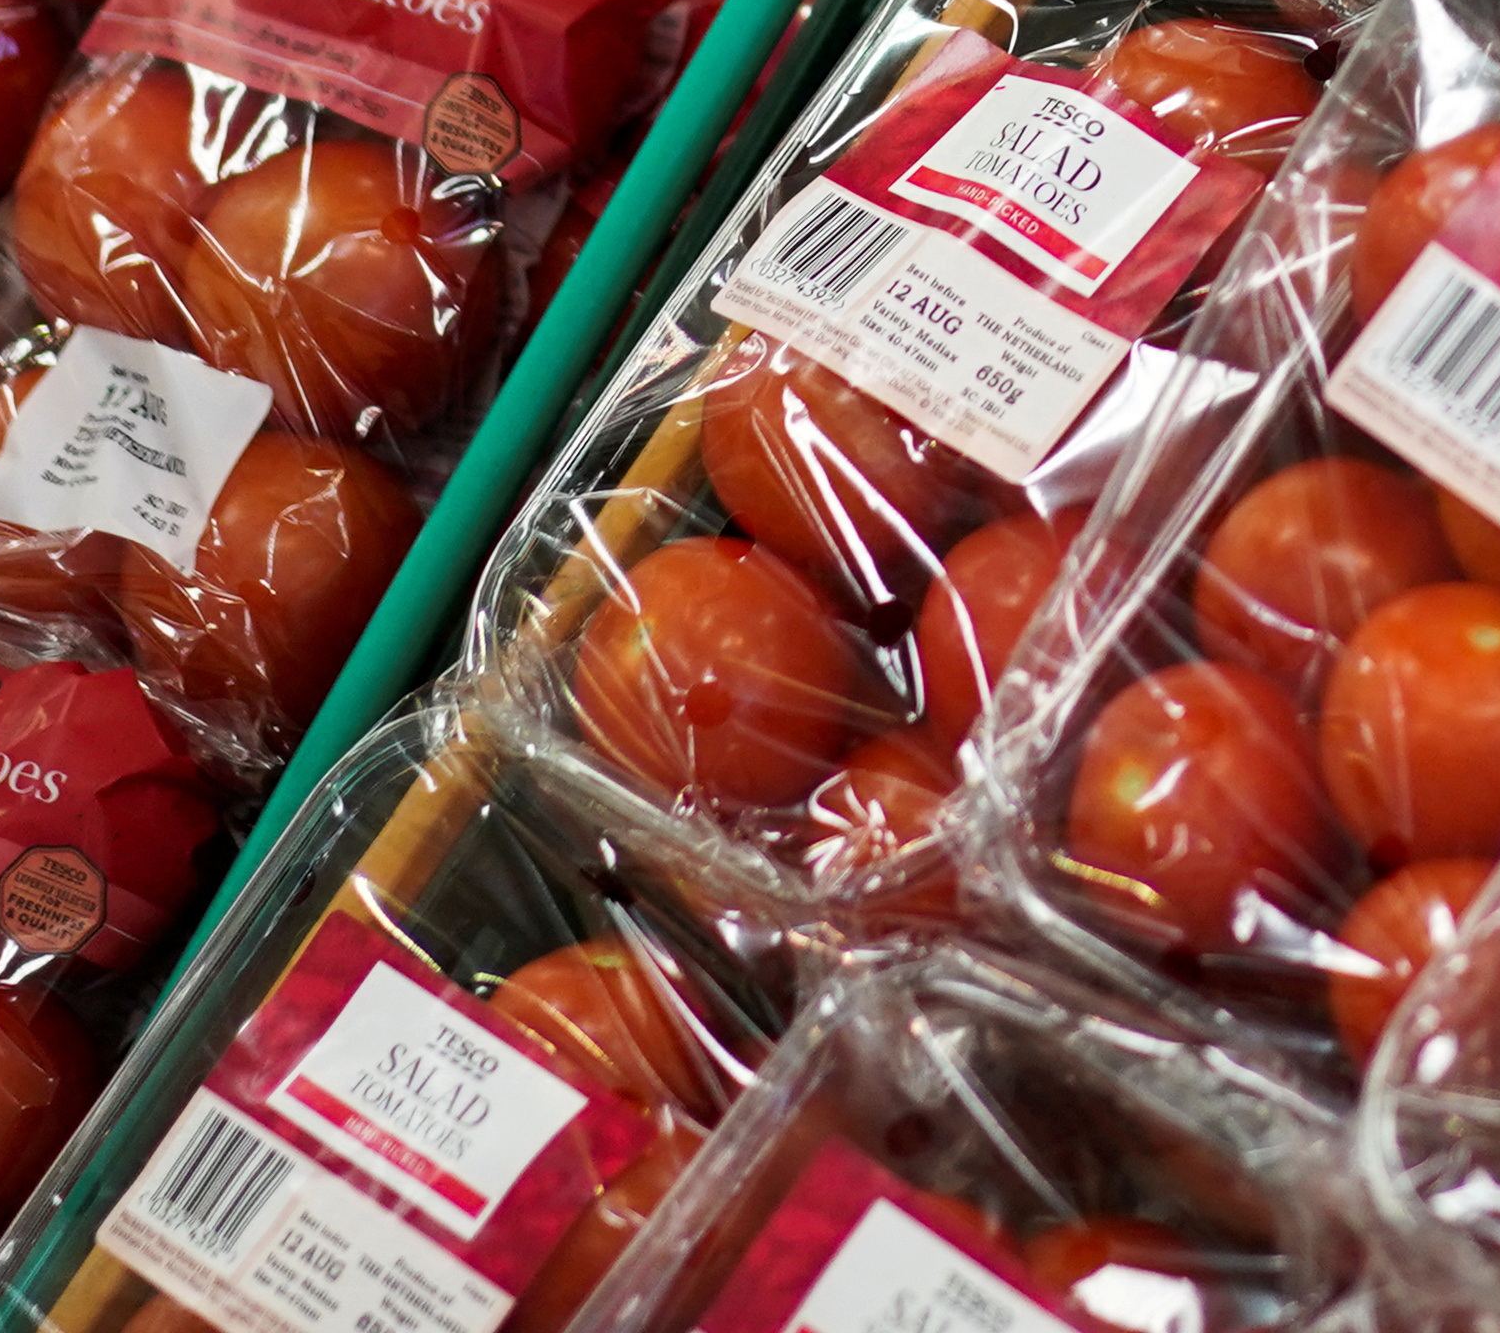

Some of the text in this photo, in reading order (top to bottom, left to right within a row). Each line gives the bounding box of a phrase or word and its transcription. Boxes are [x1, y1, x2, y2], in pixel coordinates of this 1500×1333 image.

[1040, 96, 1106, 141] TESCO
[989, 119, 1103, 193] SALAD
[964, 149, 1089, 227] TOMATOES
[886, 278, 963, 336] 12 AUG
[906, 263, 967, 307] Best before
[976, 312, 1085, 383] THE NETHERLANDS
[1013, 316, 1072, 355] Produce of
[976, 365, 1025, 405] 650g
[1001, 350, 1039, 379] Weight
[7, 893, 86, 931] FRESHNESS
[435, 1023, 501, 1076] TESCO
[377, 1042, 492, 1131] SALAD
[348, 1069, 473, 1161] TOMATOES
